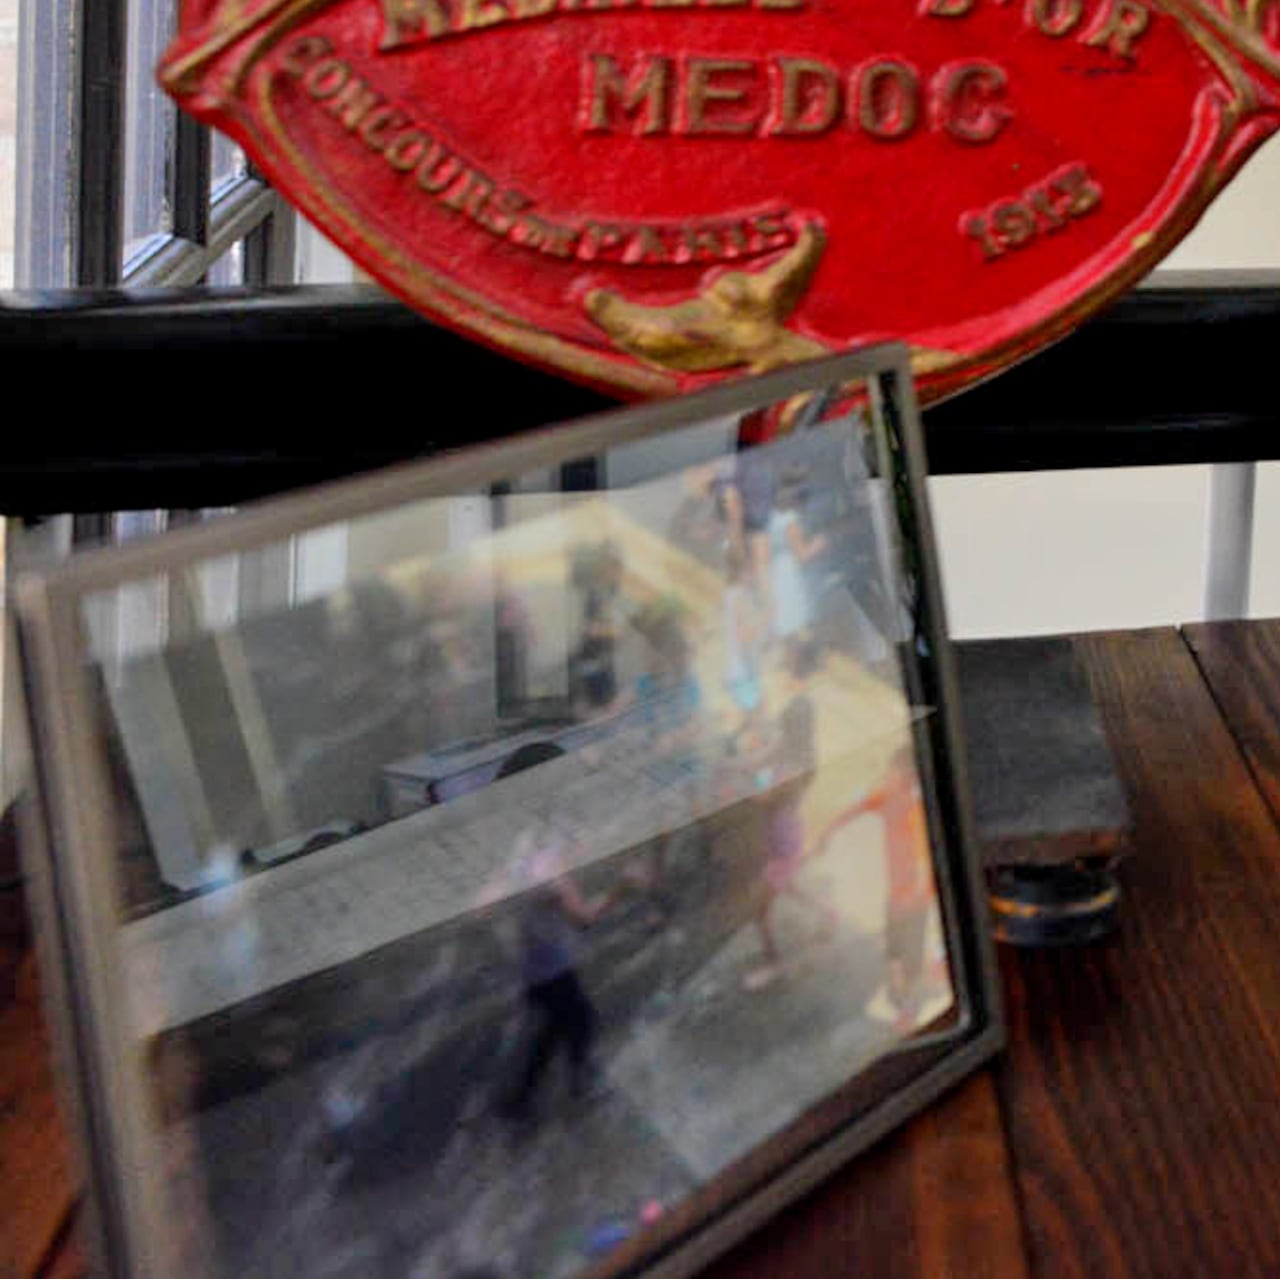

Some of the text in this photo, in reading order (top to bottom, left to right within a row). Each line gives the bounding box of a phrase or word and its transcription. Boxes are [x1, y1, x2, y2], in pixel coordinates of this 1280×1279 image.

[286, 35, 537, 239] CONCOURS
[576, 202, 798, 263] PARIS
[582, 53, 1009, 141] MEDOC
